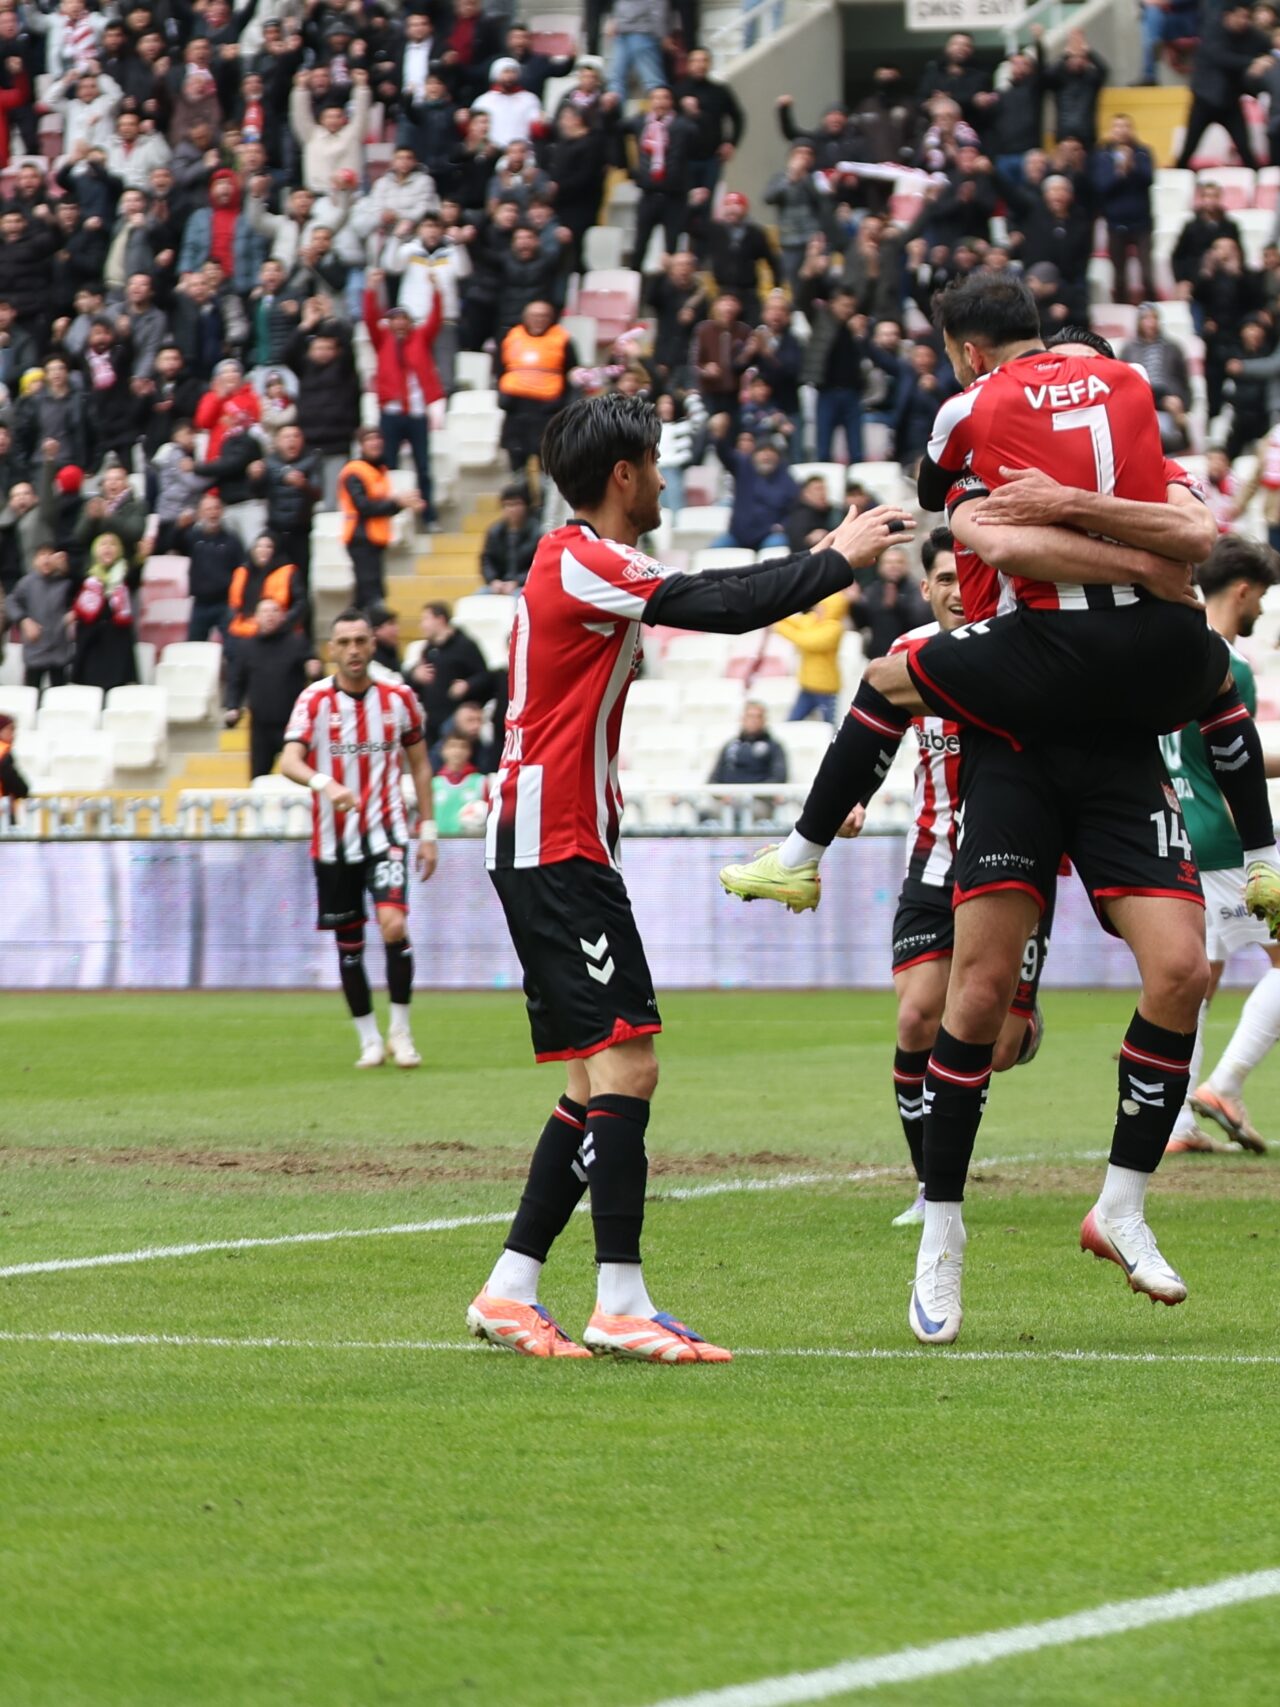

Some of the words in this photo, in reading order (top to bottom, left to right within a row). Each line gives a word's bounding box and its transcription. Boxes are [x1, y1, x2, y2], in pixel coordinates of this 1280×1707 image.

[1023, 374, 1111, 409] VEFA
[1052, 403, 1116, 496] 7
[1149, 809, 1193, 862] 14
[374, 860, 405, 889] 58
[1020, 938, 1038, 982] 9
